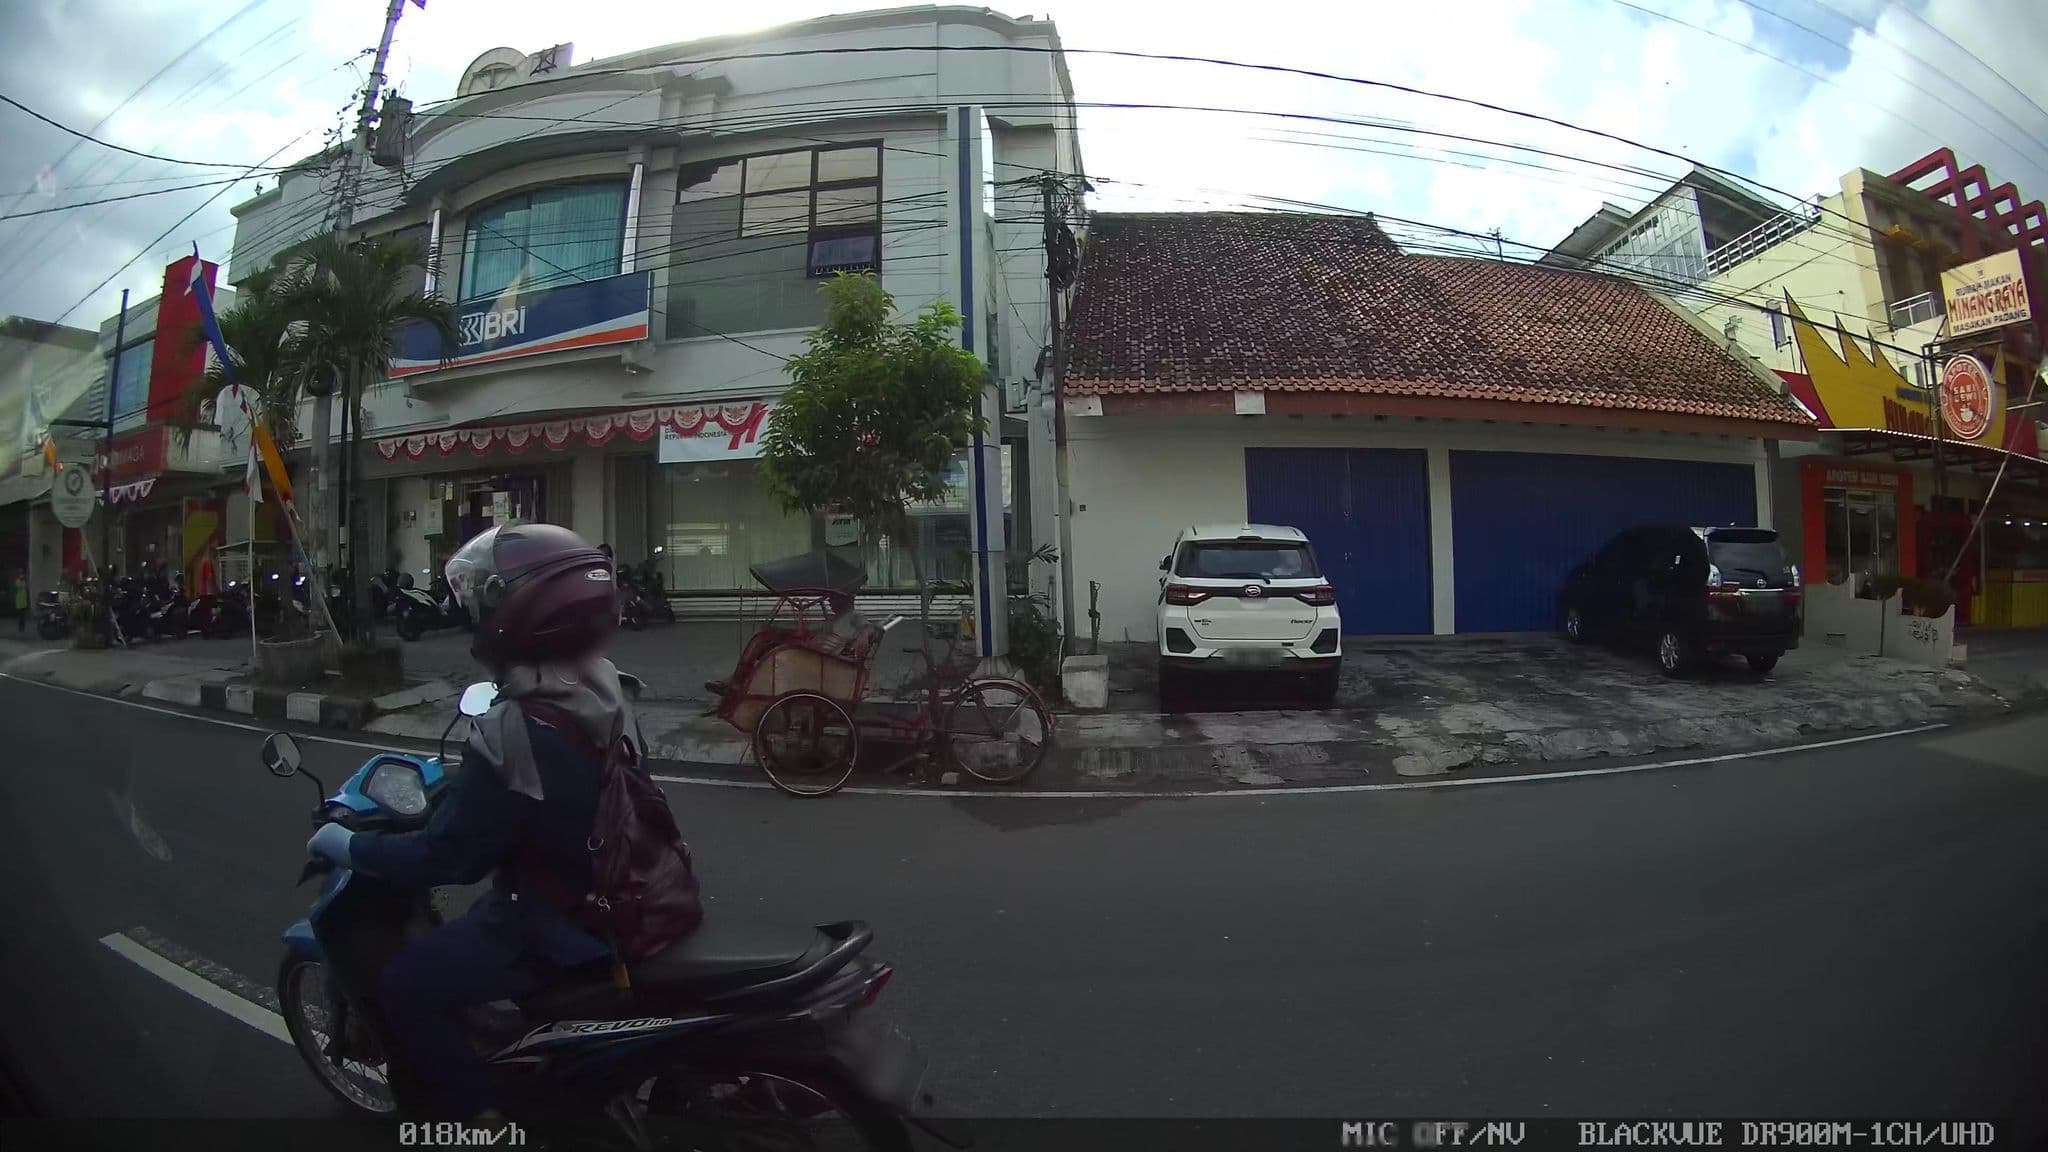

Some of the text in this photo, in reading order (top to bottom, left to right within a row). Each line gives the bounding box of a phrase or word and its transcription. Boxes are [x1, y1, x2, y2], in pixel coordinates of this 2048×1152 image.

[1984, 274, 2012, 290] MAKAN
[484, 306, 526, 340] BRI
[1953, 309, 2027, 333] MASAKAN PADANG
[571, 1018, 649, 1034] REVO
